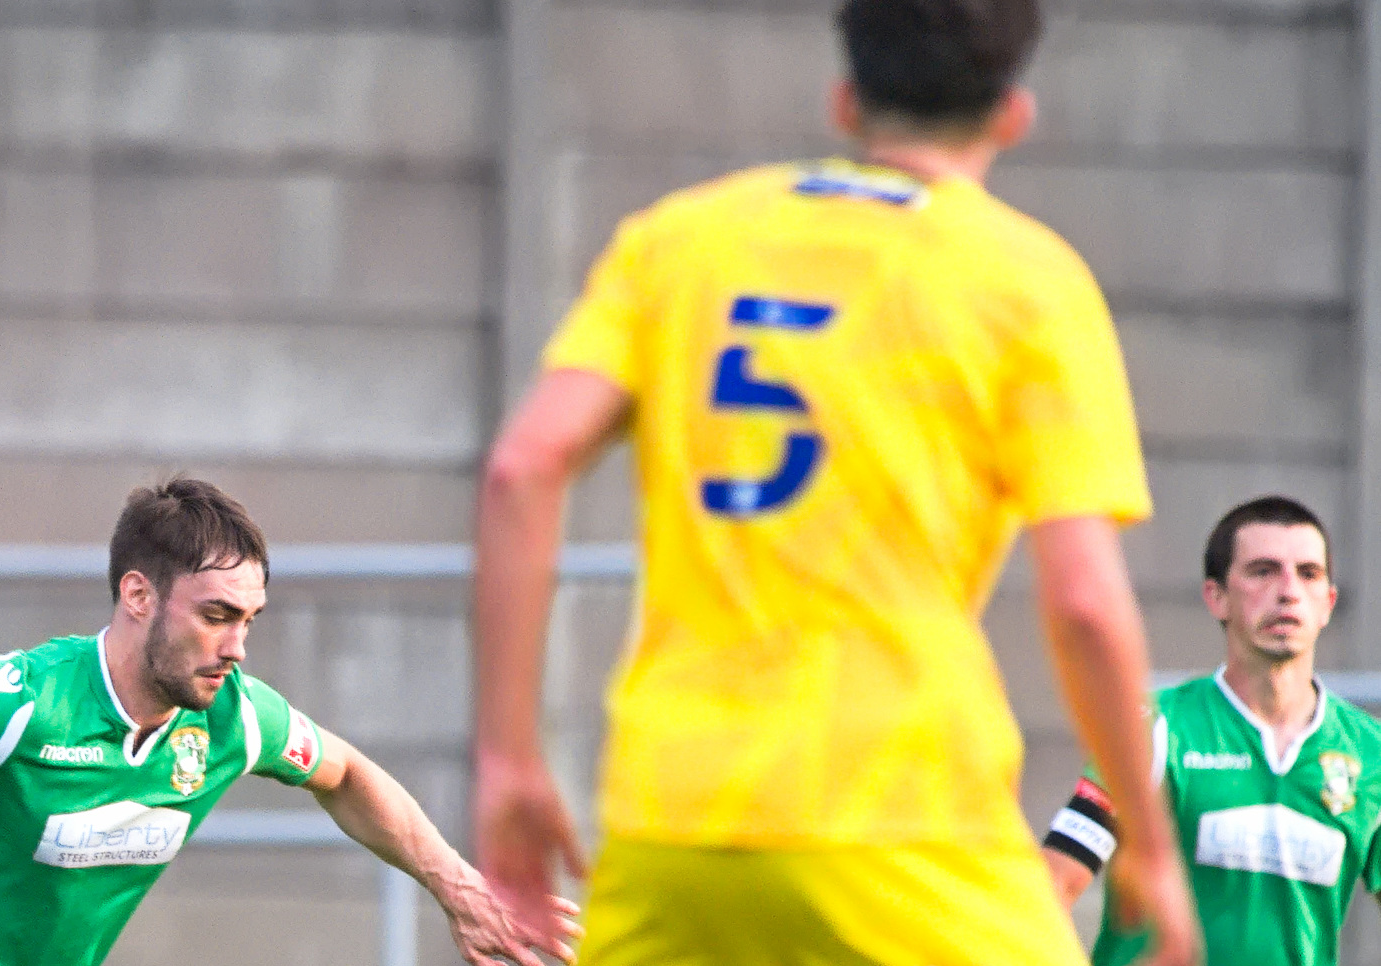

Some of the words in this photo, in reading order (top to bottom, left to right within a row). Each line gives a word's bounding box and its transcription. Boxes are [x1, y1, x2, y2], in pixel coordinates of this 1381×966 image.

[701, 297, 834, 517] 5
[39, 744, 104, 763] macron
[54, 822, 181, 851] Liberty
